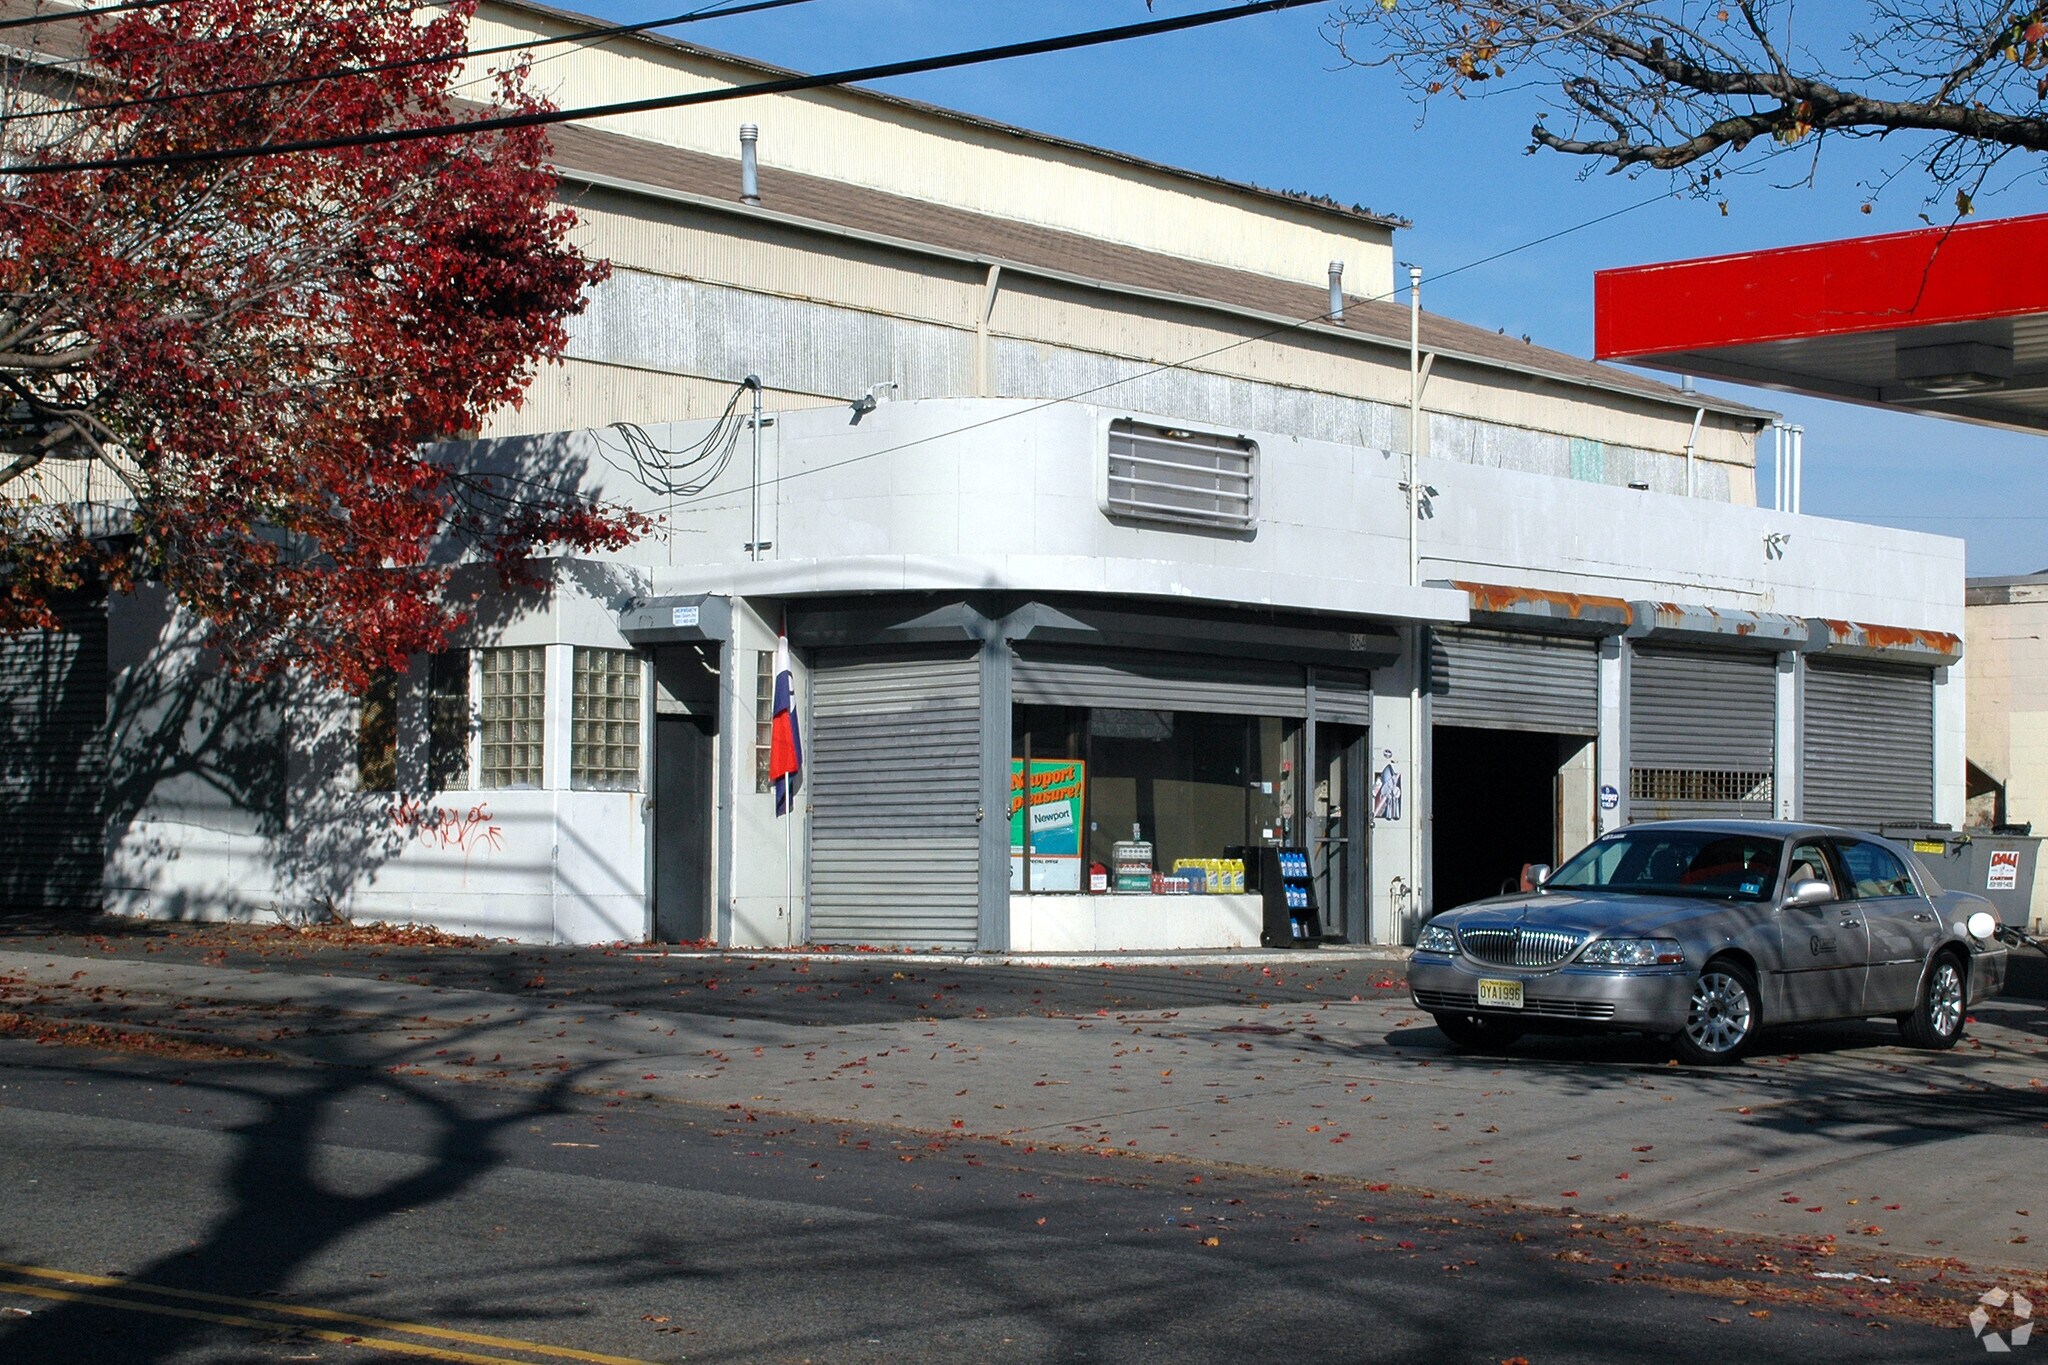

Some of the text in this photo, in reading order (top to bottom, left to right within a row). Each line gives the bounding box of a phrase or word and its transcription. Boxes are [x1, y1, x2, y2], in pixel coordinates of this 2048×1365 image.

[1351, 635, 1366, 650] 864
[1011, 766, 1075, 791] Nwport
[1011, 782, 1081, 813] peasure!
[1034, 809, 1070, 823] Newport
[1991, 853, 2019, 868] DALI
